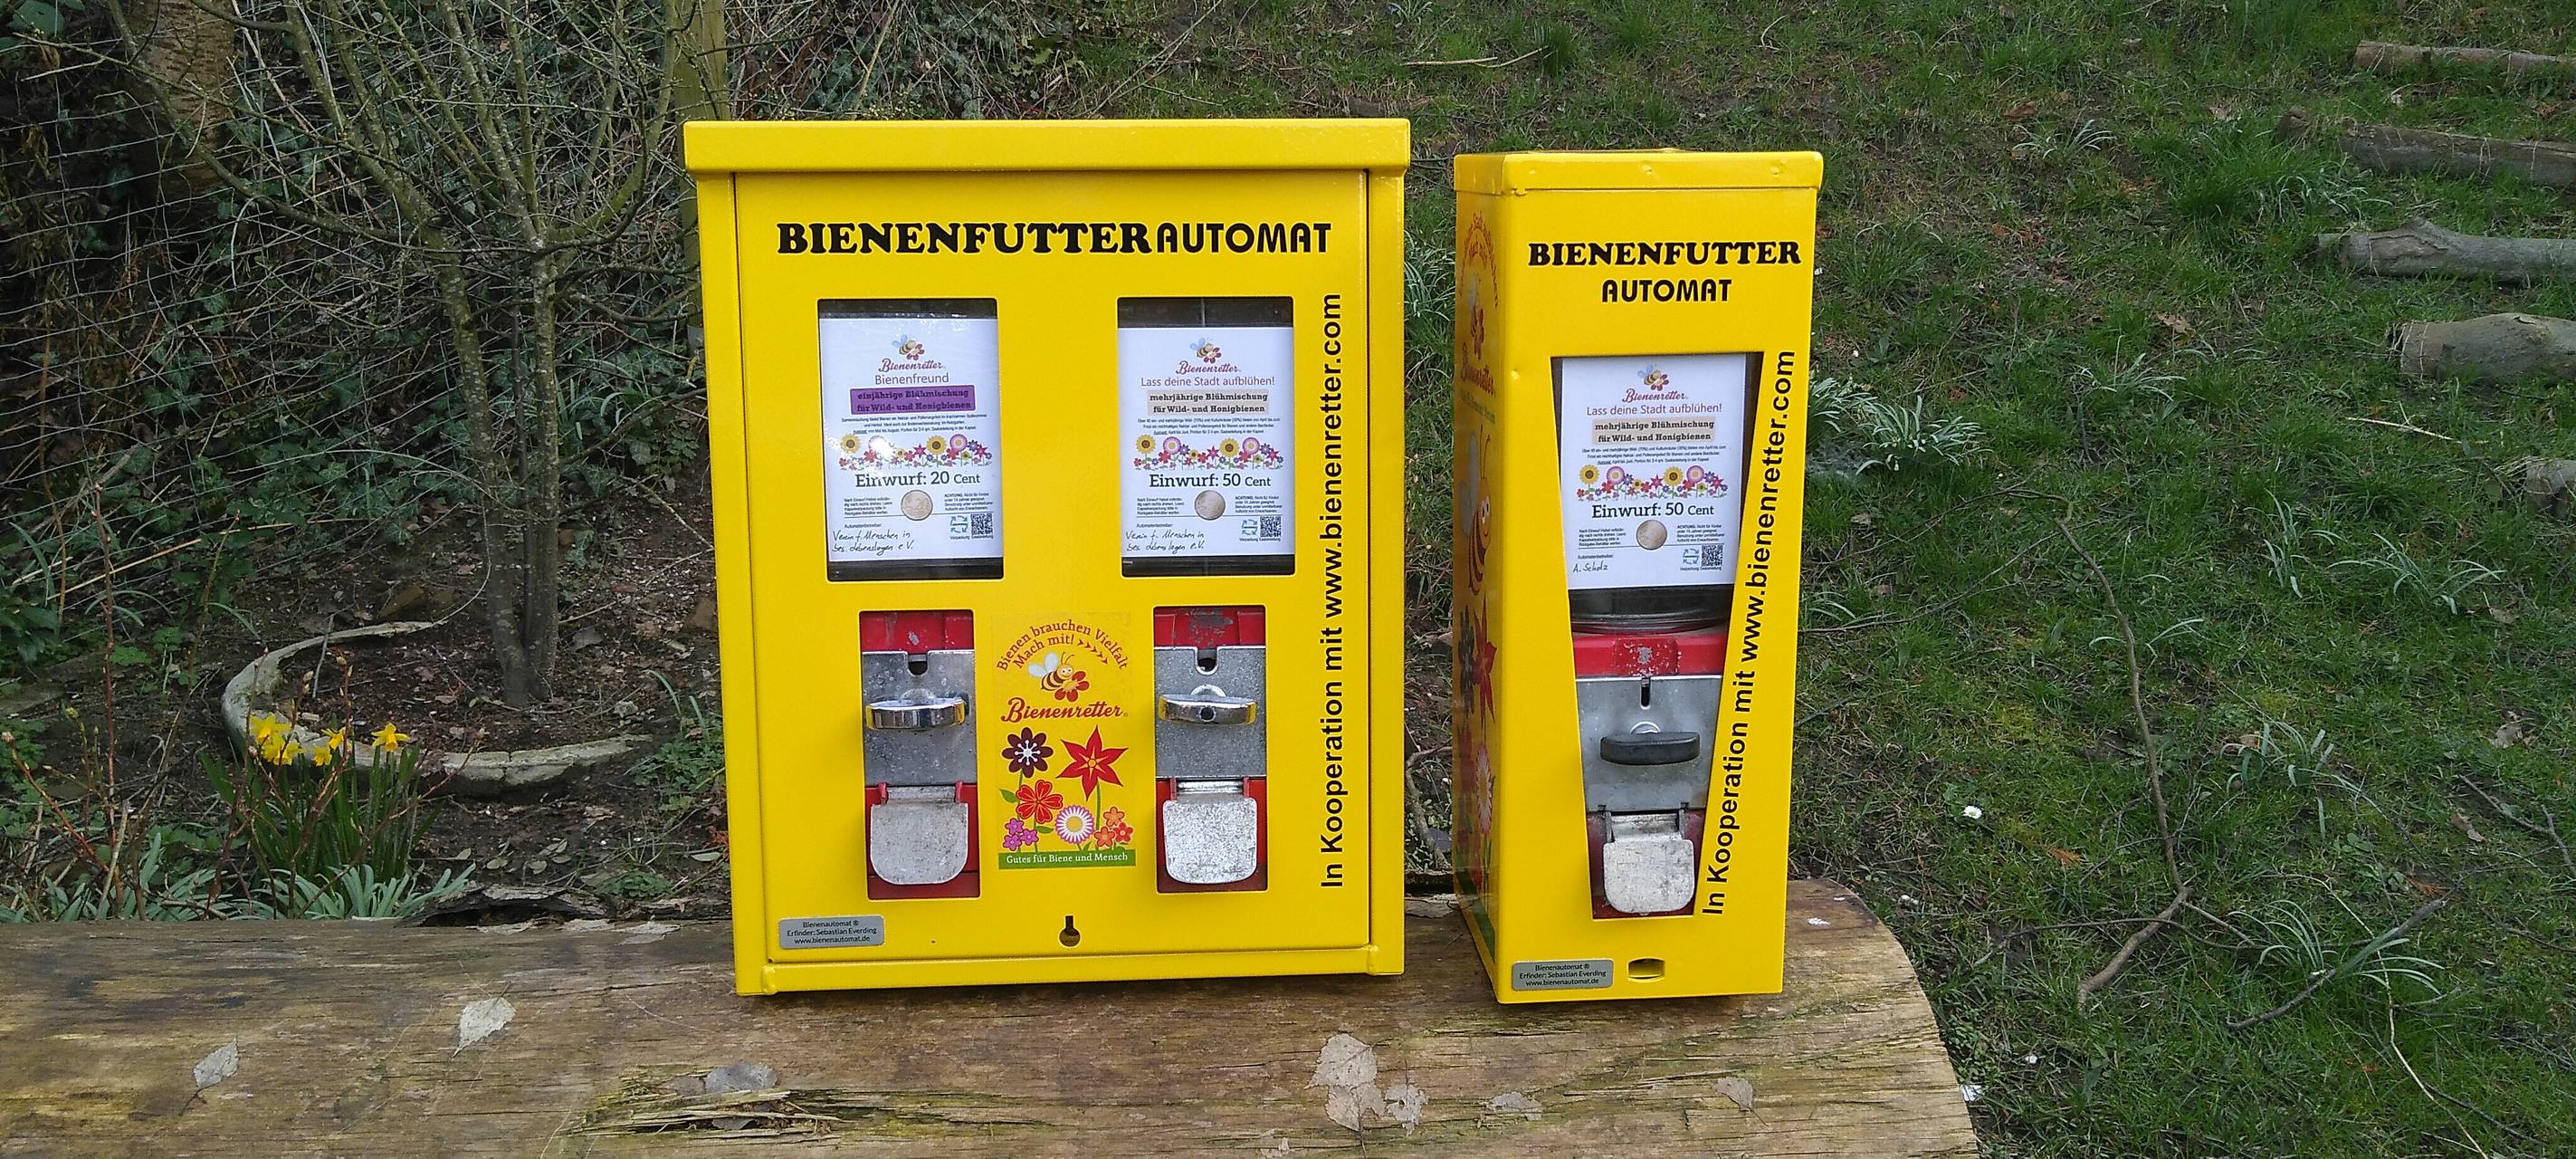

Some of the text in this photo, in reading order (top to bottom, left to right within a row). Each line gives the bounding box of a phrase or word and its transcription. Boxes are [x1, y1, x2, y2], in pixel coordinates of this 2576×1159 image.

[1528, 241, 1801, 266] BIENENFUTTER
[1601, 279, 1732, 303] AUTOMAT
[878, 358, 943, 373] Bienenretter
[1175, 359, 1239, 375] Bienenretter
[874, 373, 949, 385] Bienenfreund
[1140, 376, 1275, 387] Lass deine Stadt aufblühen!
[1150, 393, 1268, 403] mehrjährige Blühmischung
[1621, 388, 1685, 403] Bienenretter
[871, 404, 894, 412] Wild-
[896, 403, 913, 411] und
[914, 401, 971, 411] Honigbienen
[1209, 405, 1265, 415] Honigbienen
[1587, 403, 1722, 416] Lass deine Stadt aufblühen!
[1595, 420, 1714, 431] mehrjährige Blühmischung
[1598, 433, 1712, 443] für Wild- und Honigbienen
[854, 471, 980, 487] Einwurf: 20 Cent
[1149, 473, 1272, 487] Einwurf: 50 Cent
[1591, 502, 1714, 519] Einwurf: 50 Cent
[902, 530, 911, 538] in
[1572, 563, 1581, 573] A.
[1320, 292, 1348, 888] In Kooperation mit www.bienenretter.com
[1702, 350, 1795, 915] In Kooperation mit www.bienenretter.com
[996, 618, 1129, 671] Bienen brauchen Vielfalt
[1012, 634, 1075, 668] Mach mit!
[1000, 696, 1124, 723] Bienenretter
[1007, 852, 1128, 864] Gutes für Biene und Mensch
[802, 920, 853, 928] Bienenautomat
[794, 935, 871, 944] www.bienenautomat.de
[1525, 978, 1599, 986] www.bienenautomat.de
